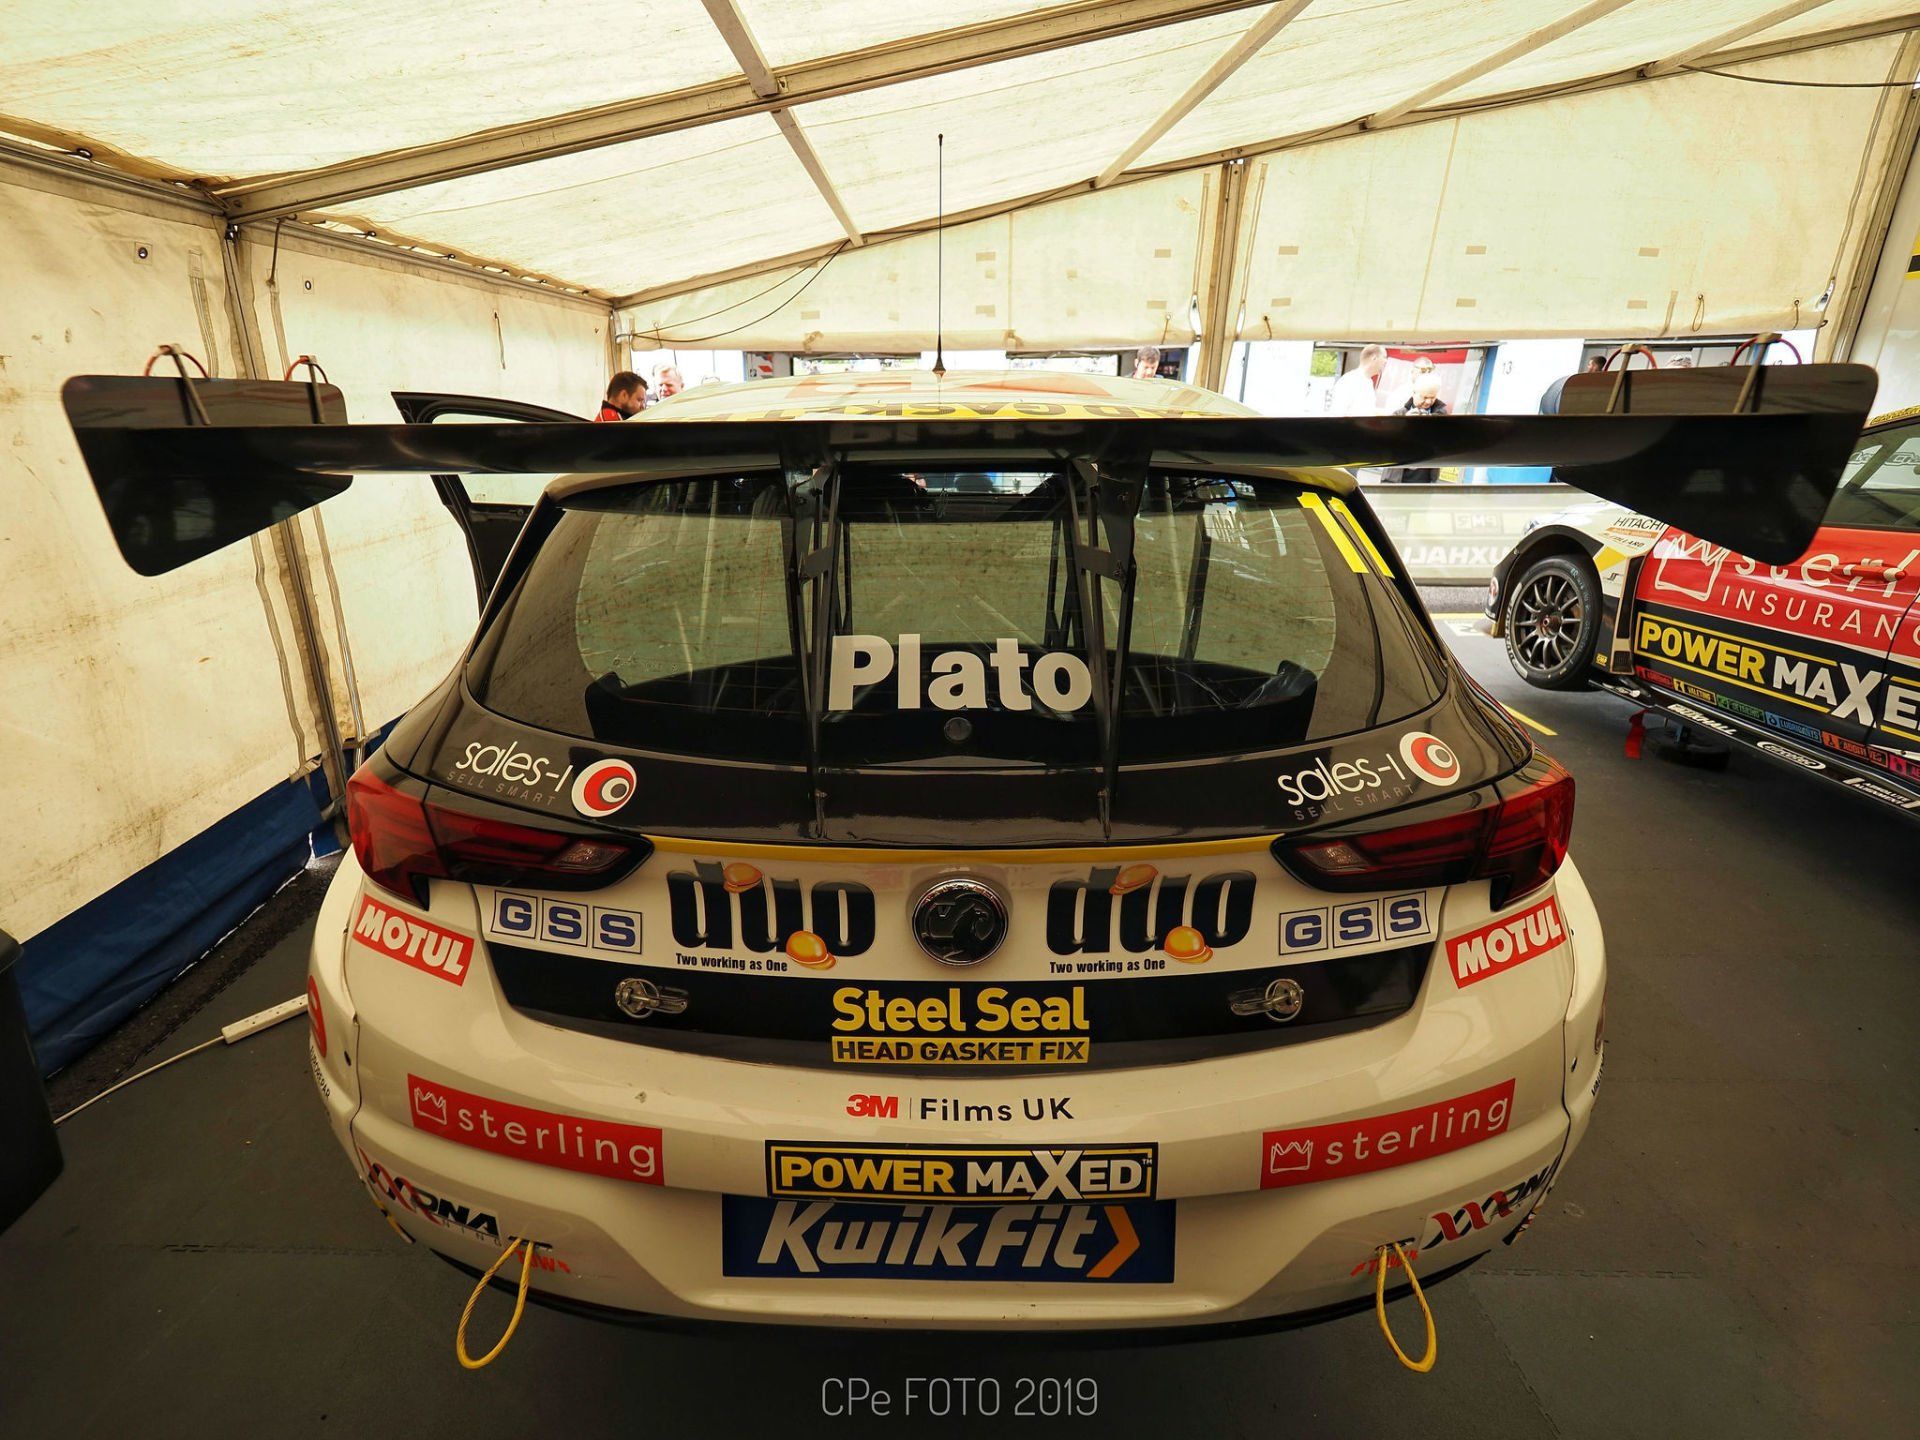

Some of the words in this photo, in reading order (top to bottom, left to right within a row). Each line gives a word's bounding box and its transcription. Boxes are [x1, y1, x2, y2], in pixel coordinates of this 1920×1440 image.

[1613, 516, 1665, 531] HITACHI
[828, 633, 1093, 712] Plato
[1640, 621, 1767, 685] POWER
[1772, 656, 1920, 728] MAXE
[446, 771, 485, 789] SELL
[495, 782, 557, 806] SMART
[1294, 801, 1344, 821] SELL
[1354, 784, 1414, 807] SMART
[499, 897, 637, 948] GSS
[666, 858, 876, 957] duo
[1046, 865, 1257, 956] duo
[1285, 898, 1422, 948] GSS
[355, 903, 465, 976] MOTUL
[676, 952, 697, 967] Two
[701, 955, 746, 971] working
[749, 960, 762, 971] as
[766, 960, 788, 972] One
[1456, 905, 1562, 980] MOTUL
[1050, 961, 1073, 974] Two
[1077, 958, 1123, 973] working
[1126, 960, 1140, 971] as
[1144, 958, 1166, 970] One
[831, 986, 967, 1032] Steel
[975, 986, 1090, 1032] Seal
[836, 1041, 914, 1061] HEAD
[920, 1041, 1033, 1061] GASKET
[1040, 1041, 1086, 1061] FIX
[846, 1094, 899, 1119] 3M
[920, 1097, 1013, 1122] Films
[1022, 1097, 1075, 1121] UK
[1325, 1097, 1508, 1165] sterling
[458, 1108, 656, 1177] sterling
[780, 1156, 957, 1195] POWER
